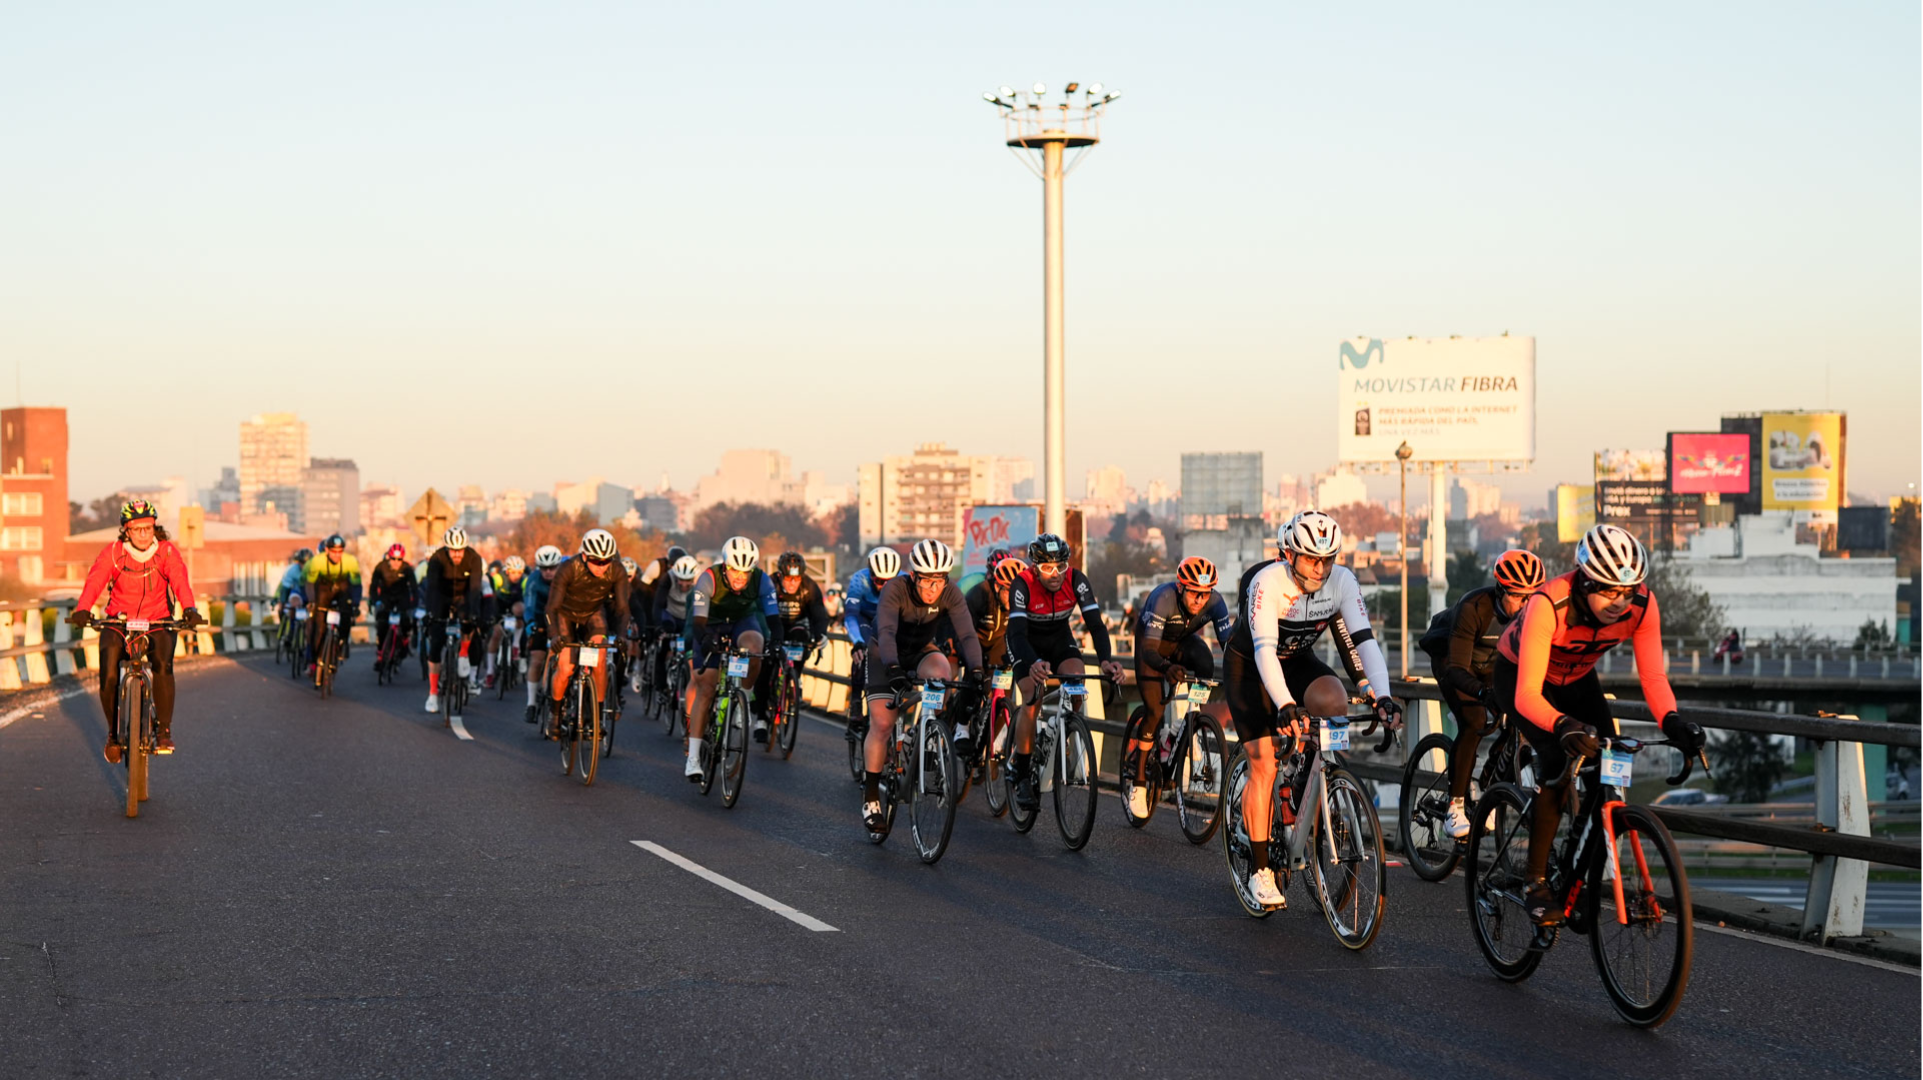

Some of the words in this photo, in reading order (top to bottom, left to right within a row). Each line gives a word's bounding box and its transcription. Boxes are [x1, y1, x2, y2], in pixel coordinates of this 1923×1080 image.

[1354, 377, 1456, 393] MOVISTAR
[1461, 375, 1519, 392] FIBRA
[1378, 406, 1425, 414] PREMIADA
[1428, 406, 1456, 414] COMO
[1457, 405, 1468, 414] LA
[1471, 404, 1518, 414] INTERNET
[1436, 416, 1453, 424] DEL
[1604, 504, 1631, 517] Prex
[1256, 588, 1264, 610] BIKE
[1356, 598, 1366, 616] BIKE
[1336, 618, 1354, 649] ITALIANA
[1350, 648, 1364, 672] GRUPO
[924, 692, 942, 702] 206
[1330, 730, 1345, 741] 97
[1610, 762, 1624, 774] 67
